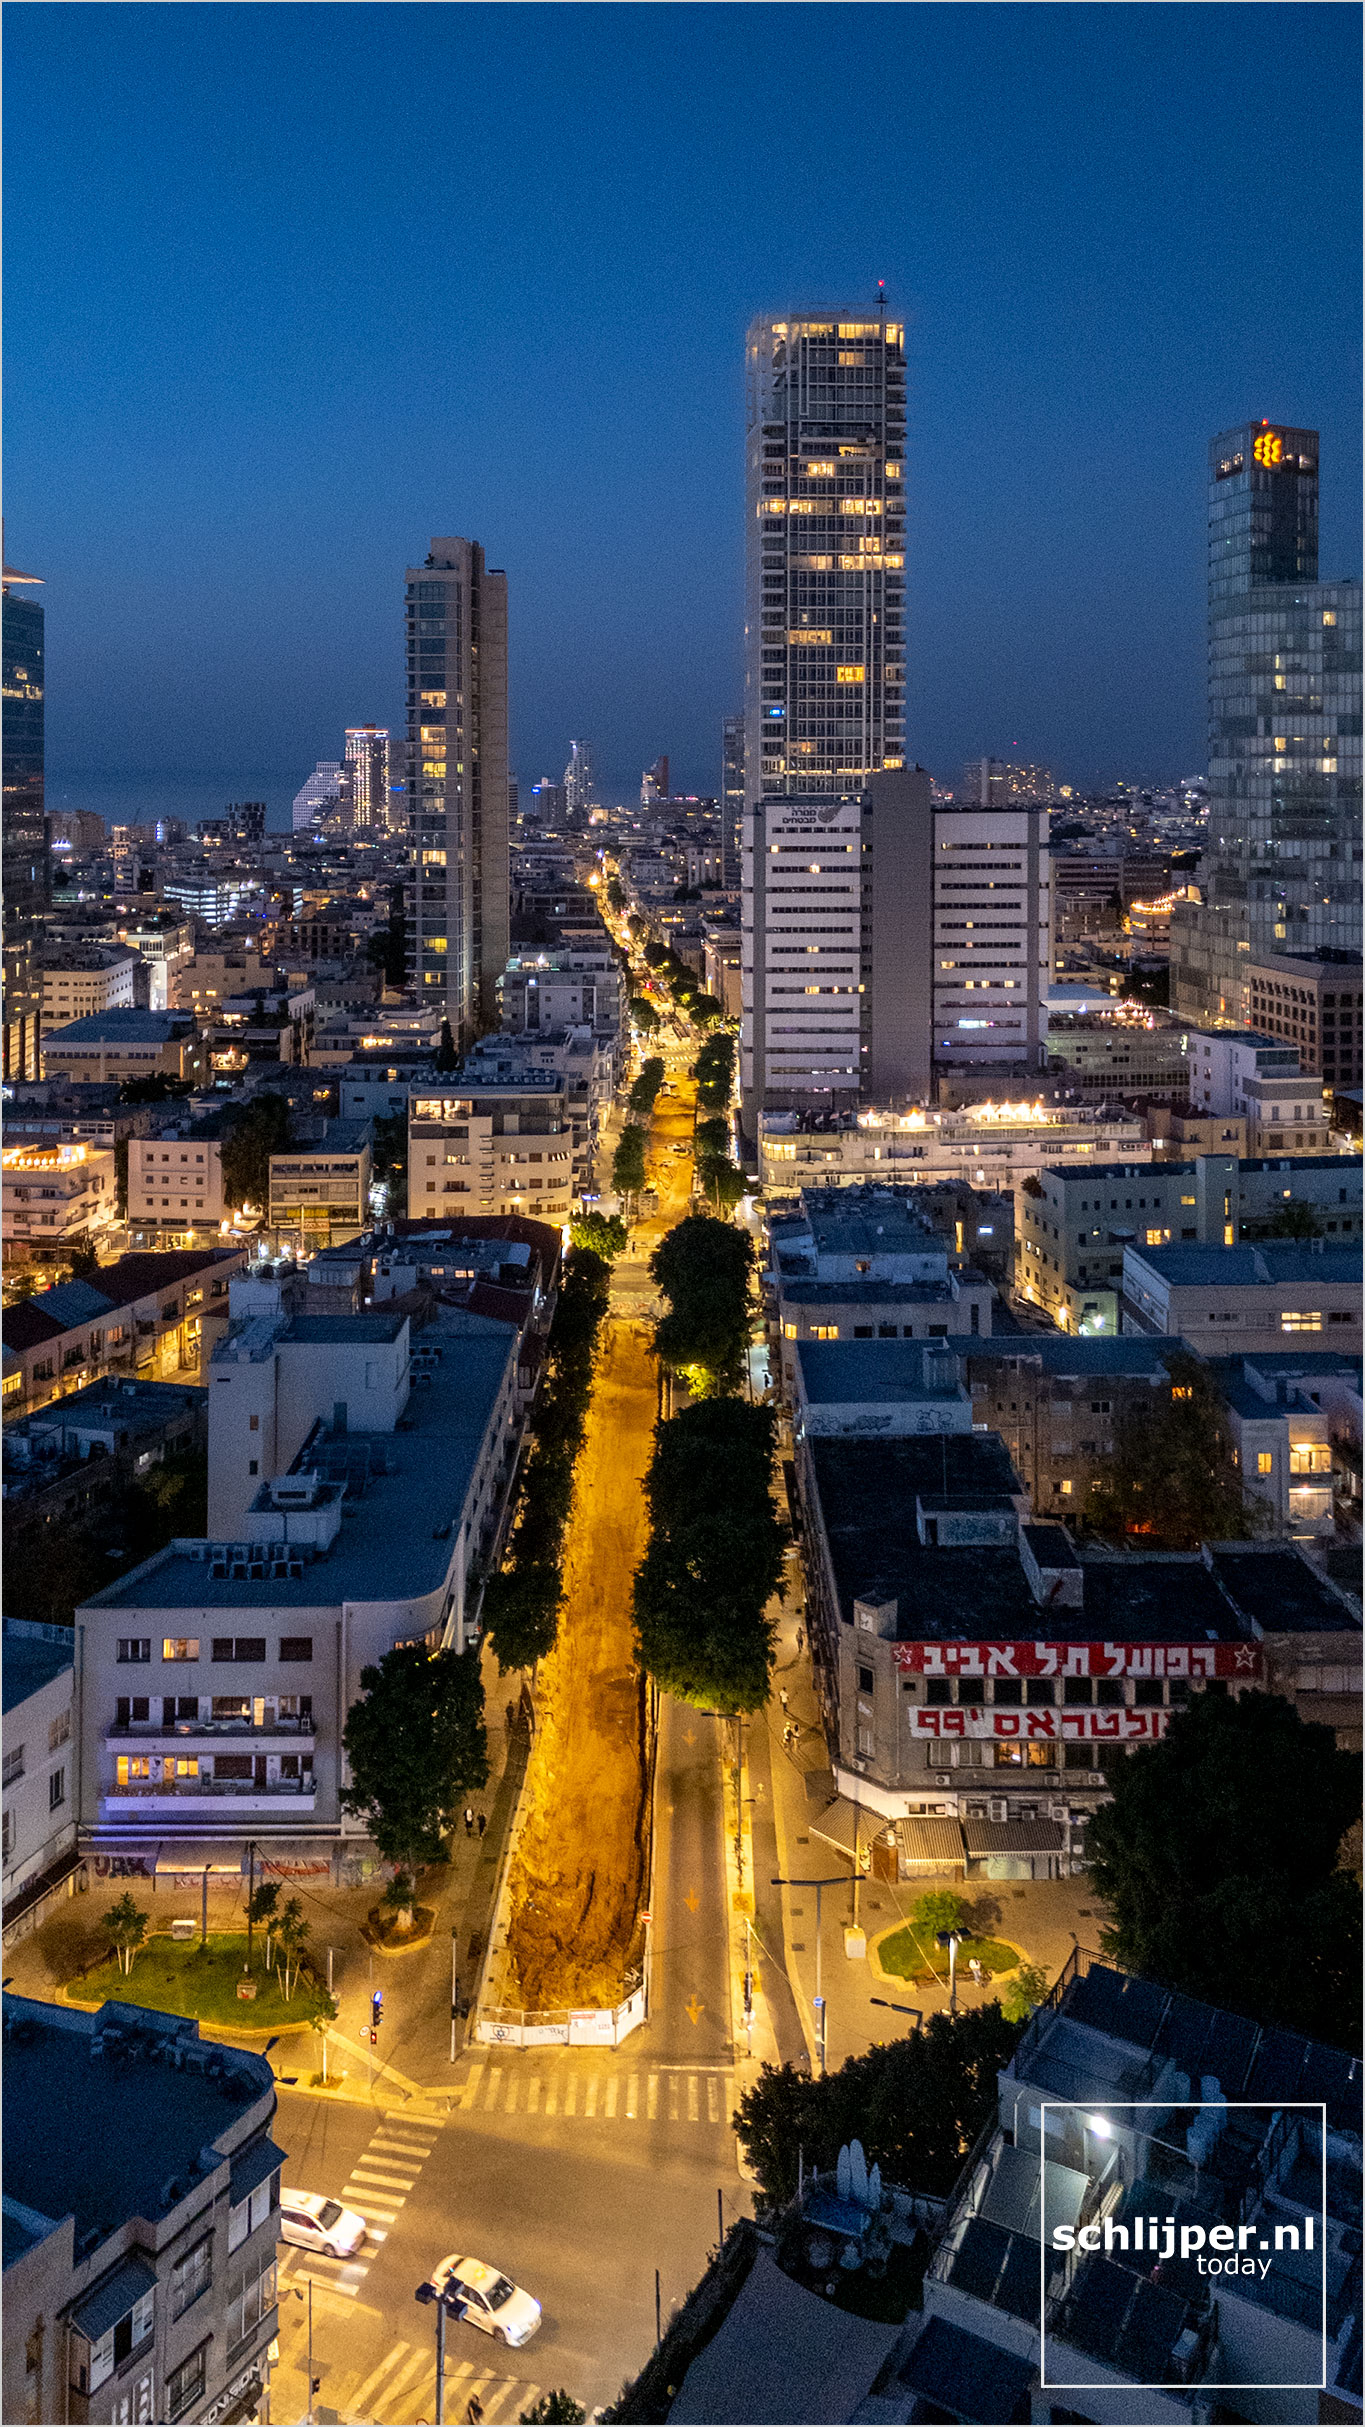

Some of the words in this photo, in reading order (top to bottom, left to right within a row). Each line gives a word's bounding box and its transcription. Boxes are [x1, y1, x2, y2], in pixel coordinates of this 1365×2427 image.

[923, 1645, 1020, 1676] אביב
[1034, 1641, 1090, 1676] תל
[1103, 1641, 1217, 1676] הפועל
[993, 1708, 1170, 1738] ולטראס
